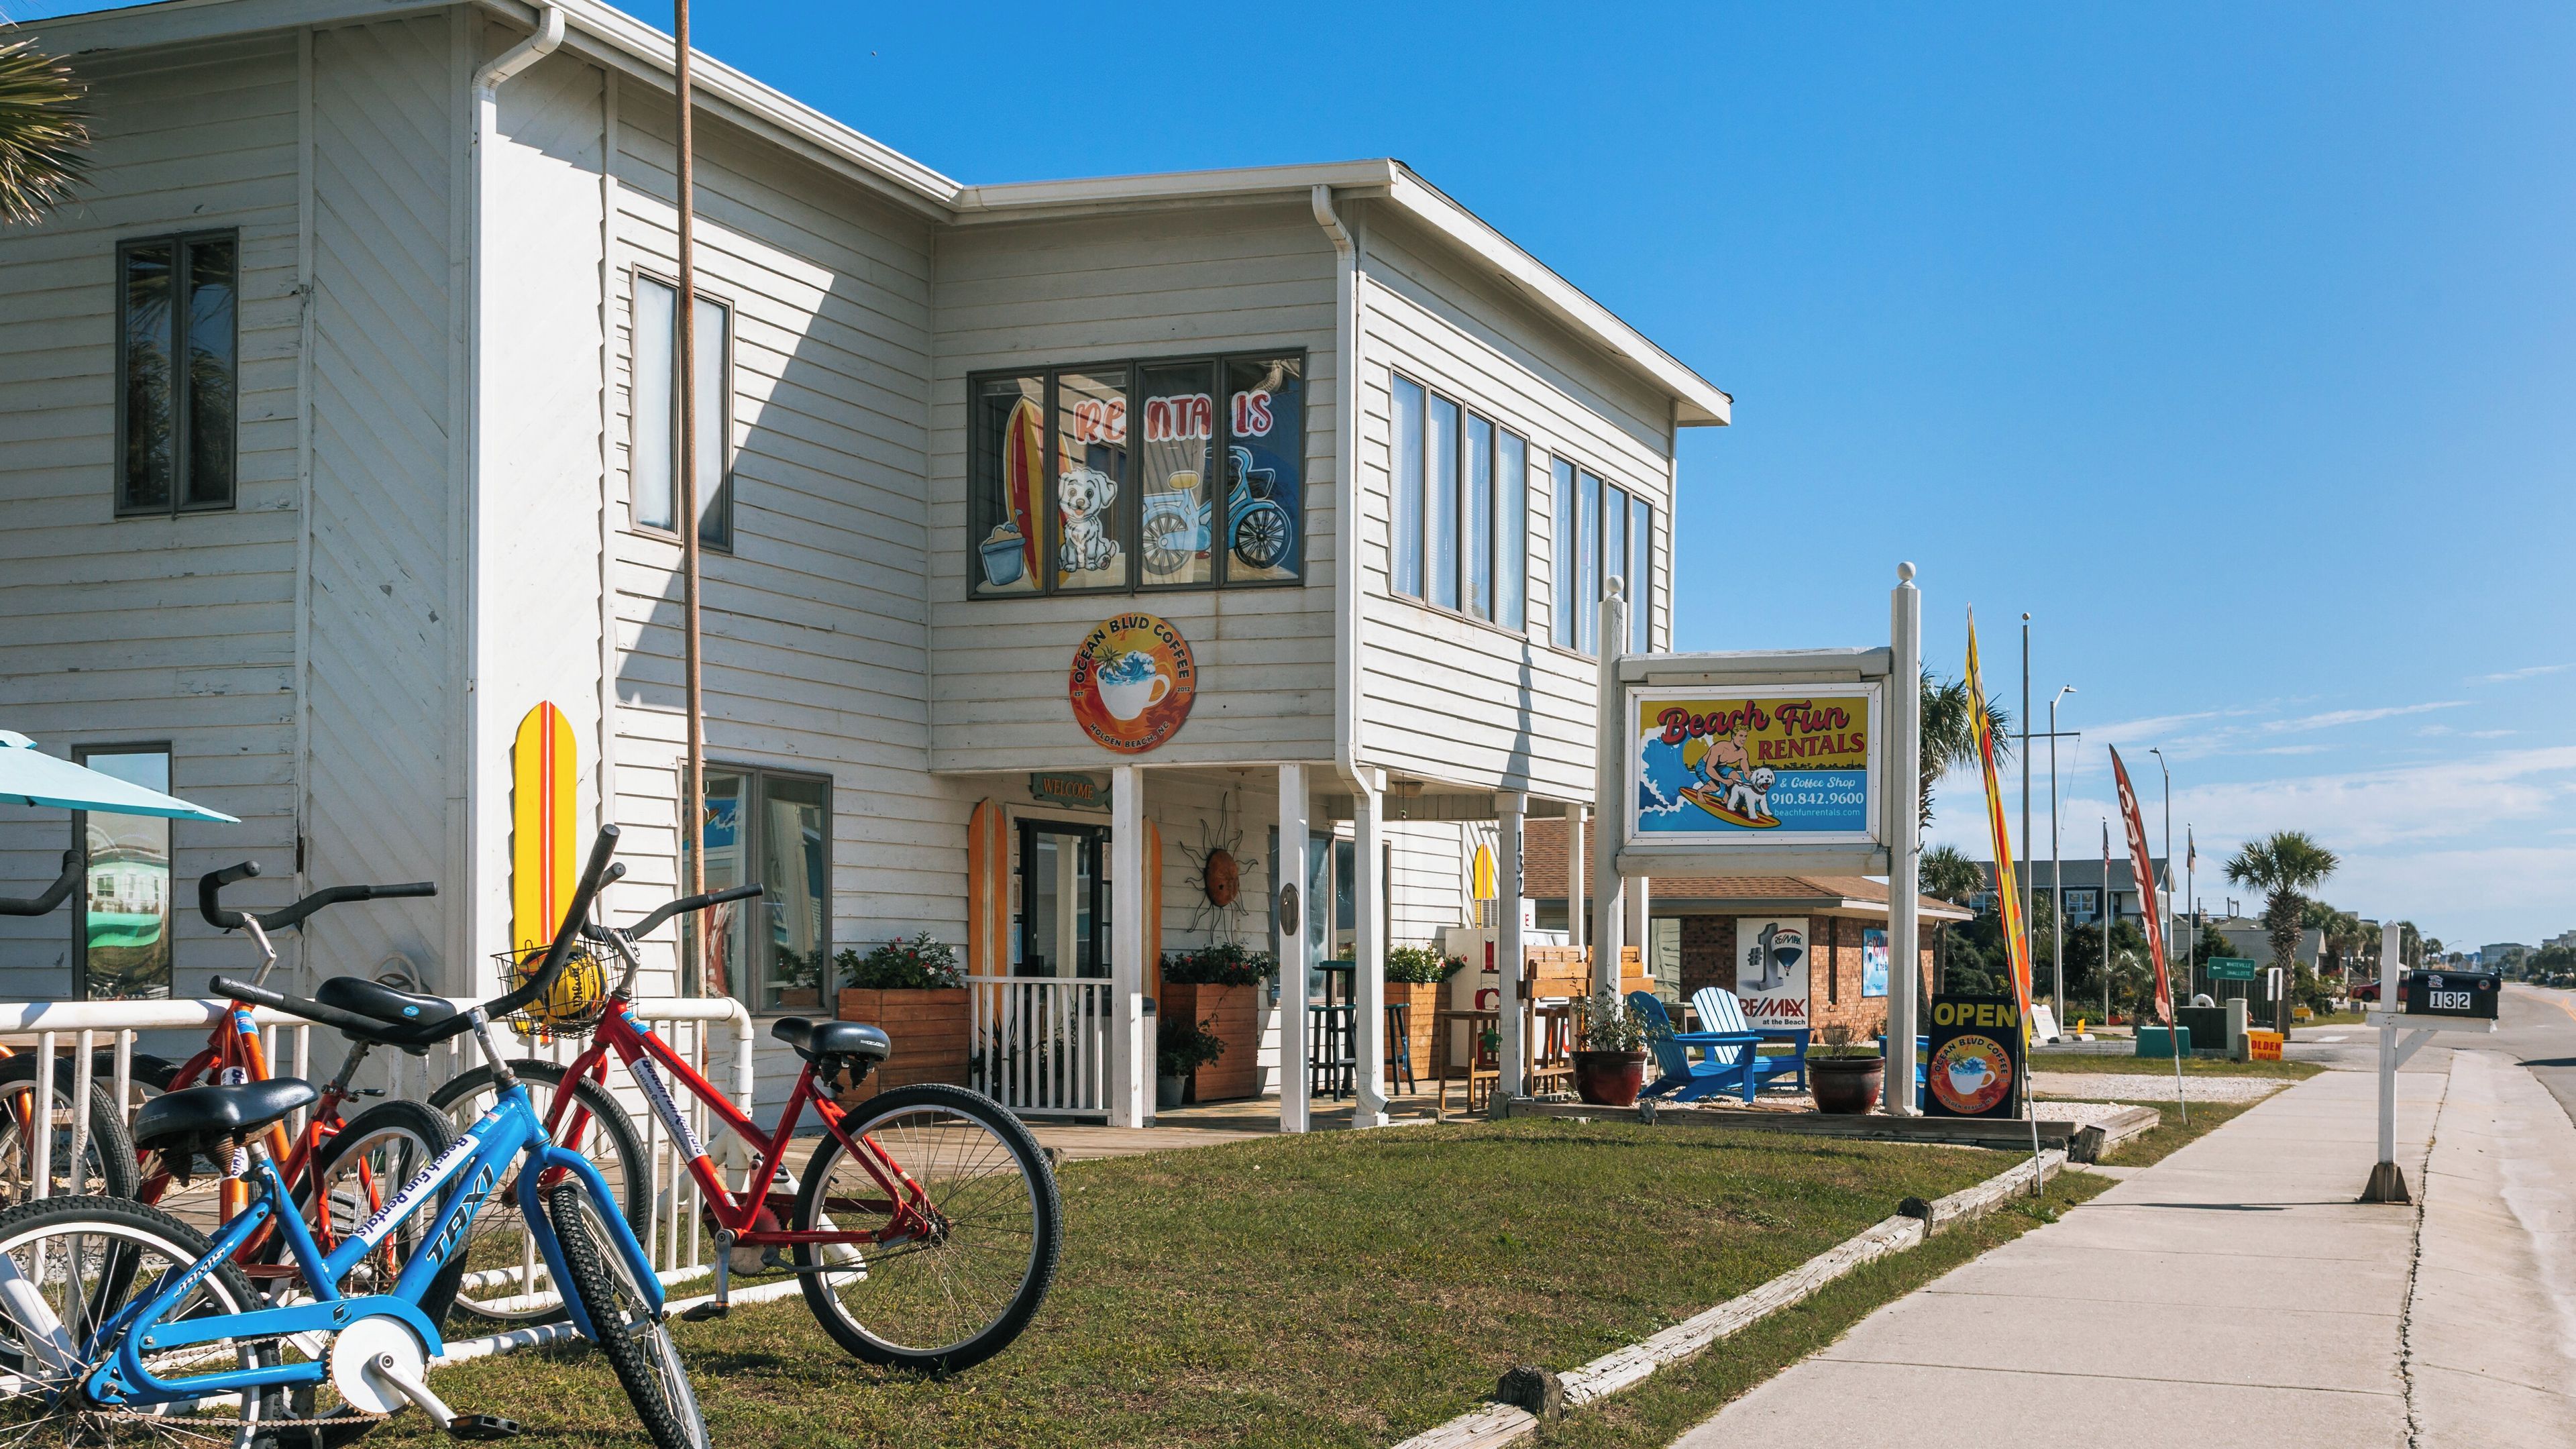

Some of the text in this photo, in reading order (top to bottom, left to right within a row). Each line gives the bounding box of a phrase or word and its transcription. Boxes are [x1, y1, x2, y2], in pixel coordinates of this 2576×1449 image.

[1074, 616, 1189, 684] OCEAN BLVD COFFEE
[1089, 723, 1121, 747] HOLDEN
[1158, 721, 1170, 735] NC
[1657, 700, 1850, 745] Beach Fun
[1758, 732, 1866, 761] RENTALS
[1043, 778, 1094, 800] WELCOME
[1779, 777, 1856, 790] & Coffee Shop
[1771, 792, 1864, 805] 910.842.9600
[1774, 808, 1860, 817] beachfunrentals.com
[1774, 934, 1801, 945] RE/MAX
[572, 967, 583, 1008] Wilson
[2433, 993, 2469, 1008] 132
[1934, 1003, 2016, 1028] OPEN
[1935, 1037, 2008, 1075] OCEAN BLVD COFFEE
[356, 1136, 468, 1237] Beach Fun Rentals
[426, 1163, 494, 1266] TAXI
[174, 1247, 225, 1298] JAMIS
